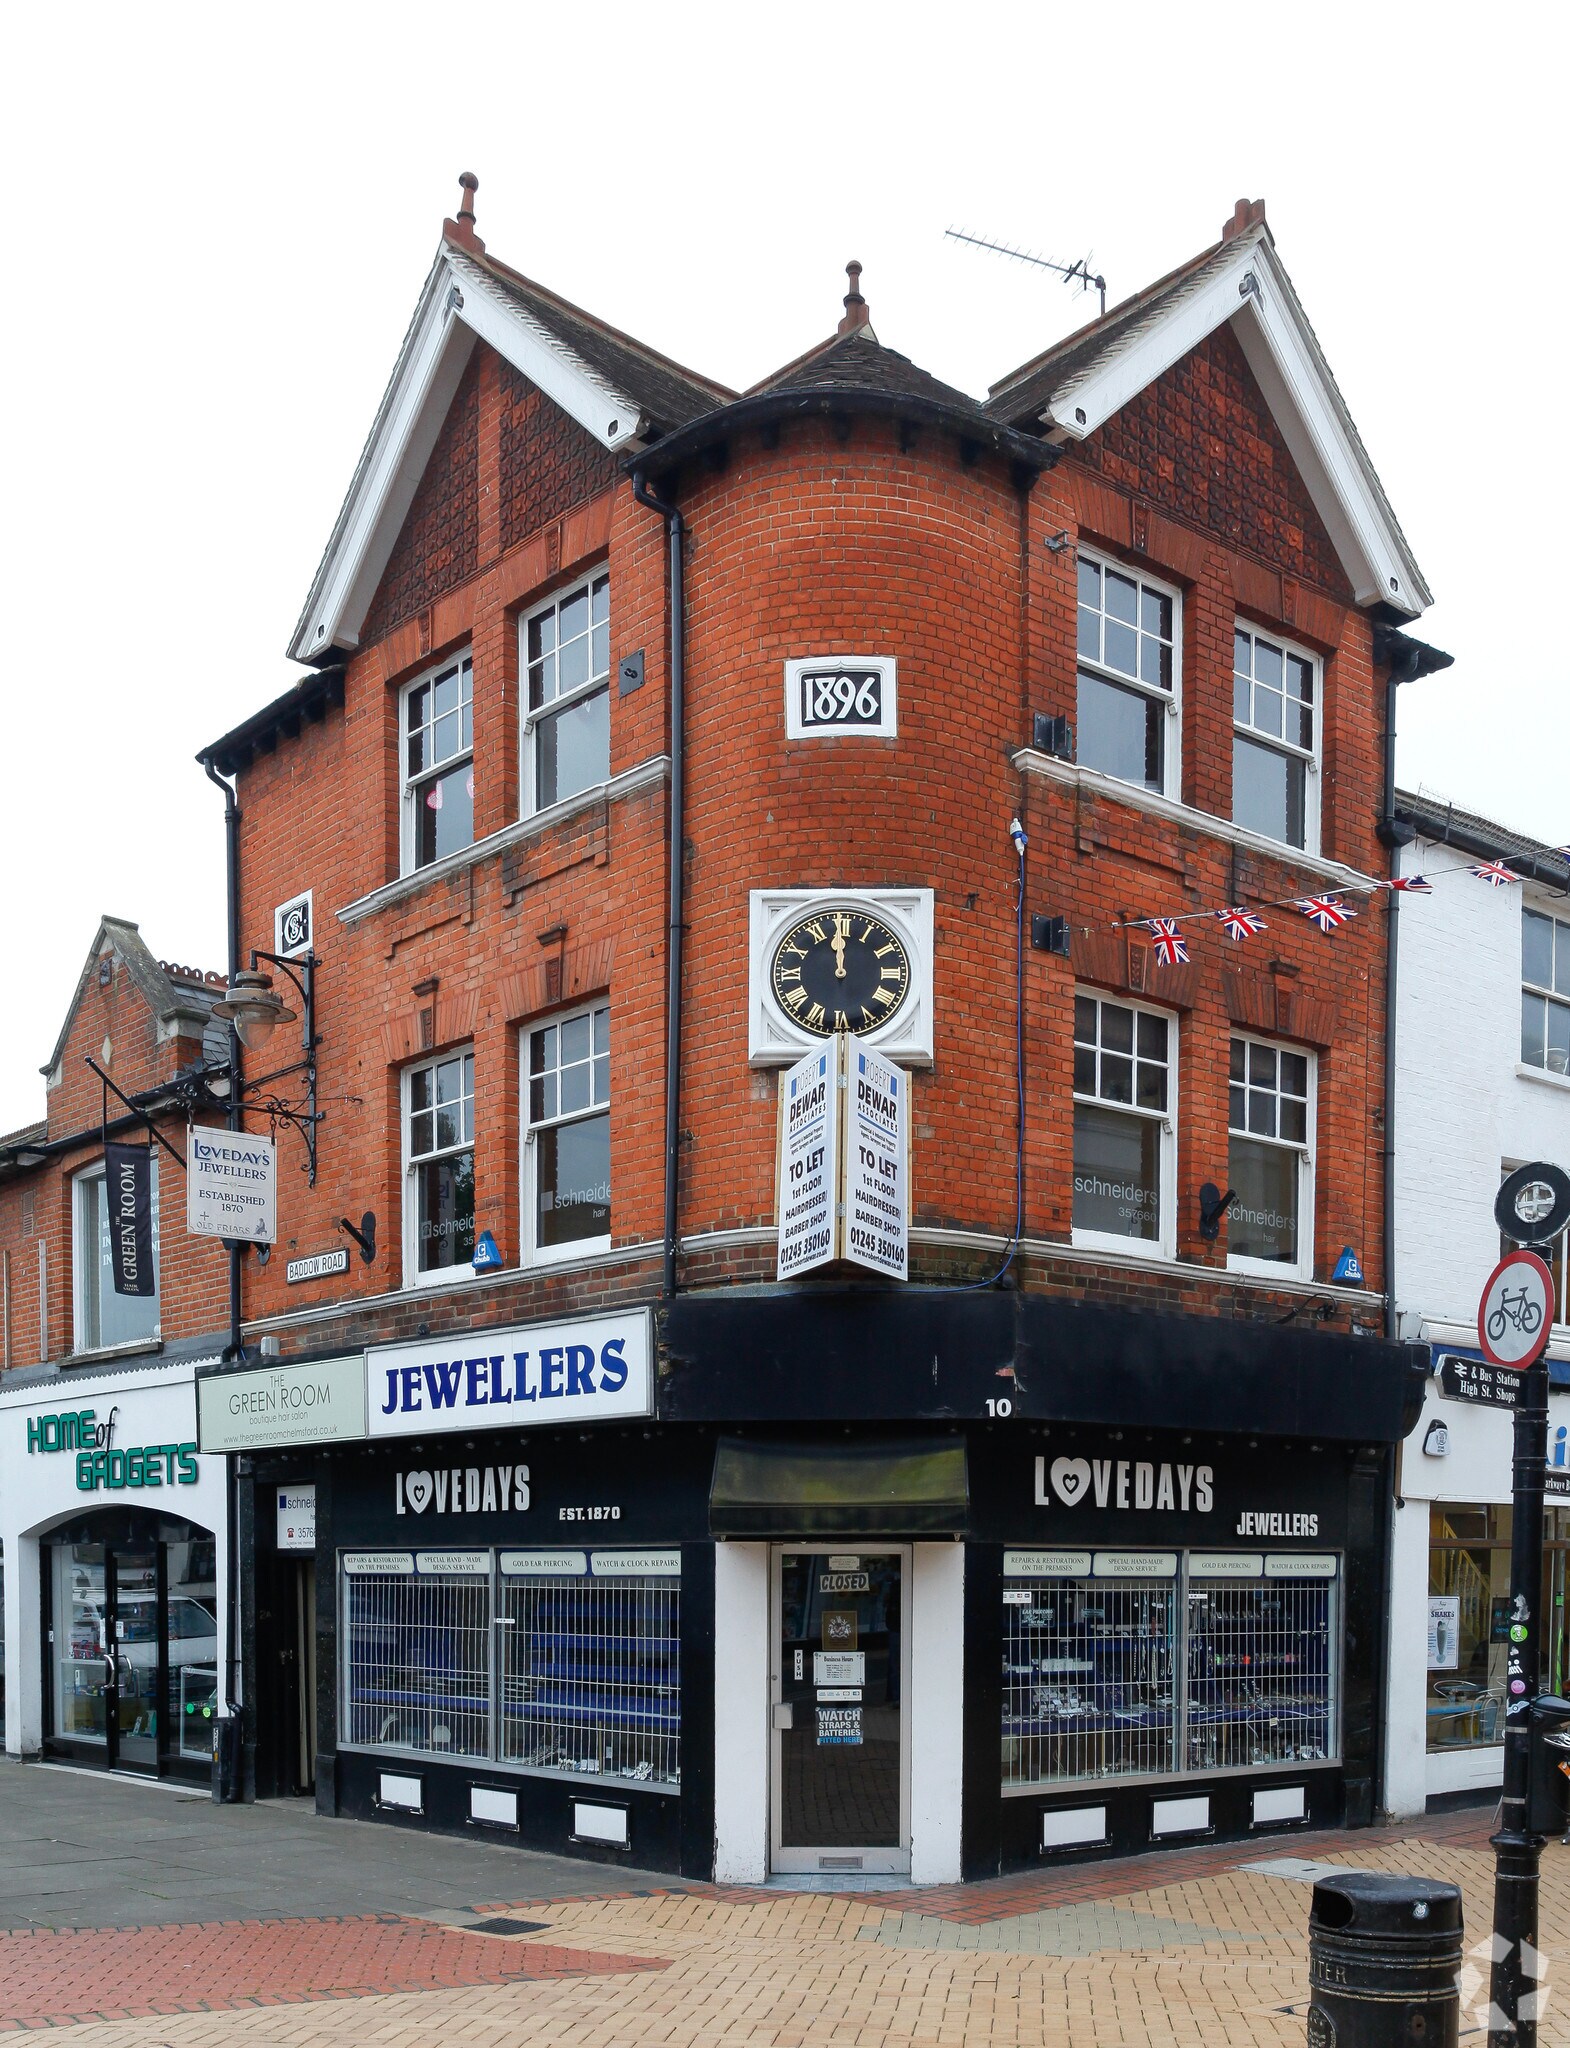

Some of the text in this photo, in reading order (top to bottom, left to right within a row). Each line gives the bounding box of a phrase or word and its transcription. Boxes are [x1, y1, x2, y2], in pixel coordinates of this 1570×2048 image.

[804, 677, 880, 722] 1896
[805, 923, 827, 945] XI
[859, 925, 874, 943] I
[786, 942, 809, 960] X
[873, 942, 895, 959] II
[781, 966, 801, 982] IX
[880, 966, 901, 980] III
[785, 985, 809, 1012] VIII
[872, 985, 896, 1007] IIII
[805, 1002, 826, 1026] VII
[833, 1010, 850, 1029] VI
[861, 1005, 876, 1023] V
[865, 1059, 890, 1091] ROBERT
[789, 1082, 825, 1123] DEWAR
[858, 1079, 897, 1121] DEWAR
[789, 1103, 826, 1133] ASSOCIATES
[858, 1102, 897, 1132] ASSOCIATES
[199, 1162, 267, 1180] JEWELLERS
[789, 1147, 825, 1182] TO LET
[859, 1145, 897, 1181] TO LET
[199, 1190, 265, 1206] ESTABLISHED
[792, 1175, 822, 1200] 1st FLOOR
[863, 1174, 895, 1198] 1st FLOOR
[1074, 1176, 1158, 1205] schneiders
[222, 1203, 244, 1213] 1870
[593, 1207, 607, 1218] hair
[785, 1190, 828, 1220] HAIRDRESSER/
[855, 1189, 901, 1220] HAIRDRESSER/
[1118, 1206, 1157, 1223] 357660
[120, 1163, 138, 1280] GREEN ROOM
[196, 1221, 250, 1234] OLD FRIARS
[785, 1210, 826, 1239] BARBER SHOP
[855, 1209, 900, 1237] BARBER SHOP
[1227, 1204, 1296, 1230] schneiders
[780, 1228, 830, 1264] 01245 350160
[850, 1227, 904, 1263] 01245 350160
[1263, 1232, 1276, 1243] hair
[289, 1254, 343, 1278] BADDOW ROAD
[270, 1375, 285, 1388] THE
[382, 1338, 628, 1415] JEWELLERS
[1471, 1366, 1520, 1387] & Bus Station
[229, 1383, 331, 1415] GREEN ROOM
[1460, 1380, 1516, 1404] High St. Shops
[250, 1410, 308, 1425] boutique hair salon
[985, 1398, 1012, 1417] 10
[27, 1406, 119, 1459] HOME of
[223, 1424, 338, 1444] www.thegreenroomchelmsford.co.uk
[76, 1442, 198, 1490] GADGETS
[1237, 1511, 1318, 1536] JEWELLERS
[627, 1559, 649, 1567] CLOCK
[651, 1559, 679, 1567] REPAIRS
[822, 1574, 867, 1590] CLOSED
[1430, 1610, 1455, 1618] SHAKES
[818, 1710, 860, 1721] WATCH
[818, 1721, 860, 1729] STRAPS &
[819, 1729, 861, 1737] BATTERIES
